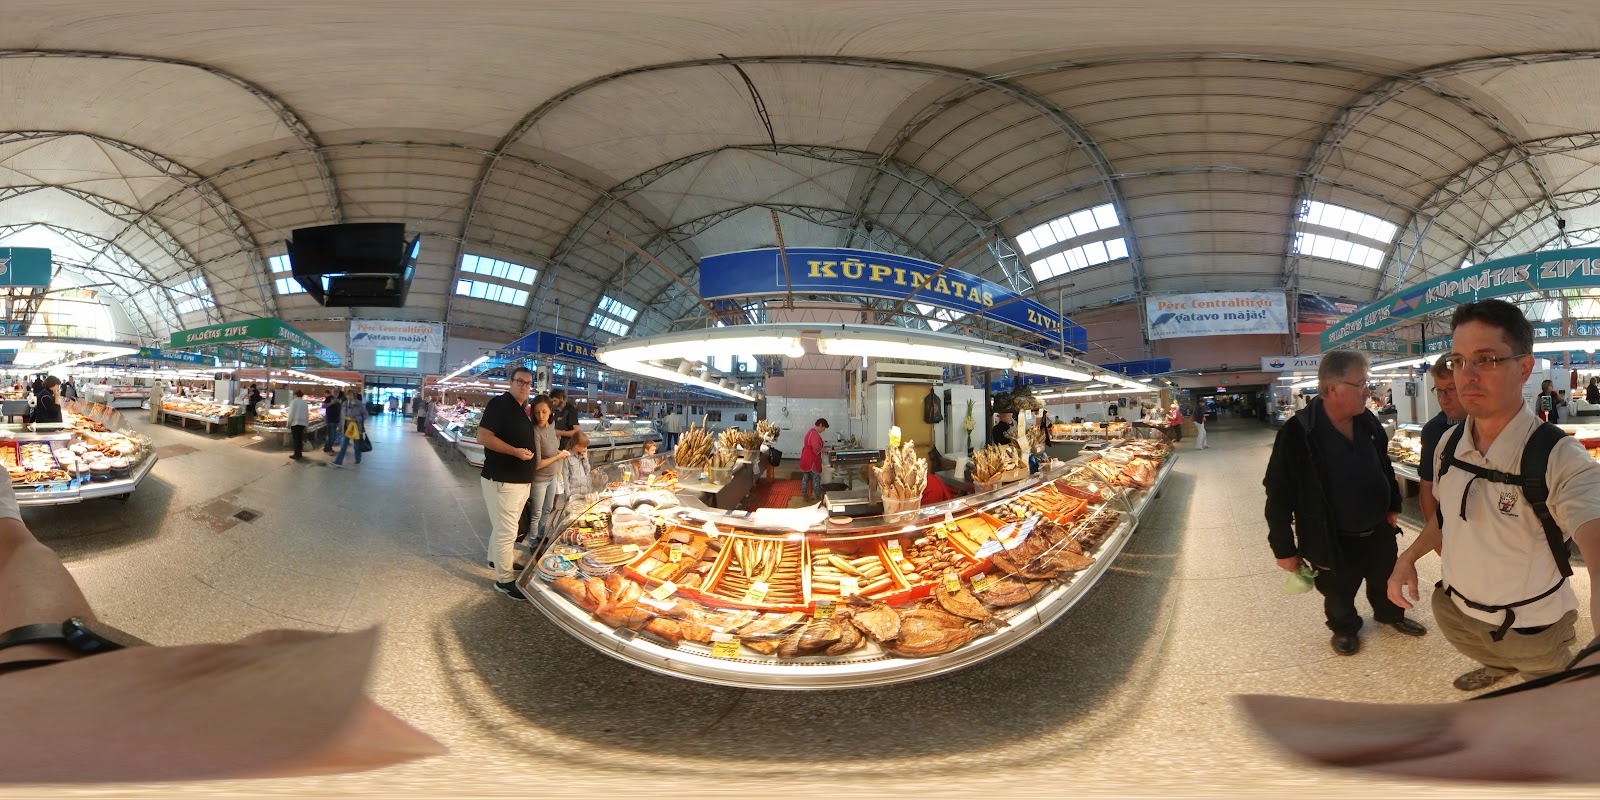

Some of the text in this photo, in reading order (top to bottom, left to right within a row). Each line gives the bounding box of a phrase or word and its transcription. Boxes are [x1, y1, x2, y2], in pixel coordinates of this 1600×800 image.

[808, 258, 994, 307] KŪPINĀTAS
[1425, 264, 1532, 304] KŪPINĀTAS
[1175, 309, 1266, 324] gatavo mājās!
[225, 326, 248, 337] ZIVIS
[368, 333, 396, 341] gatavo
[558, 341, 596, 357] JŪRAS
